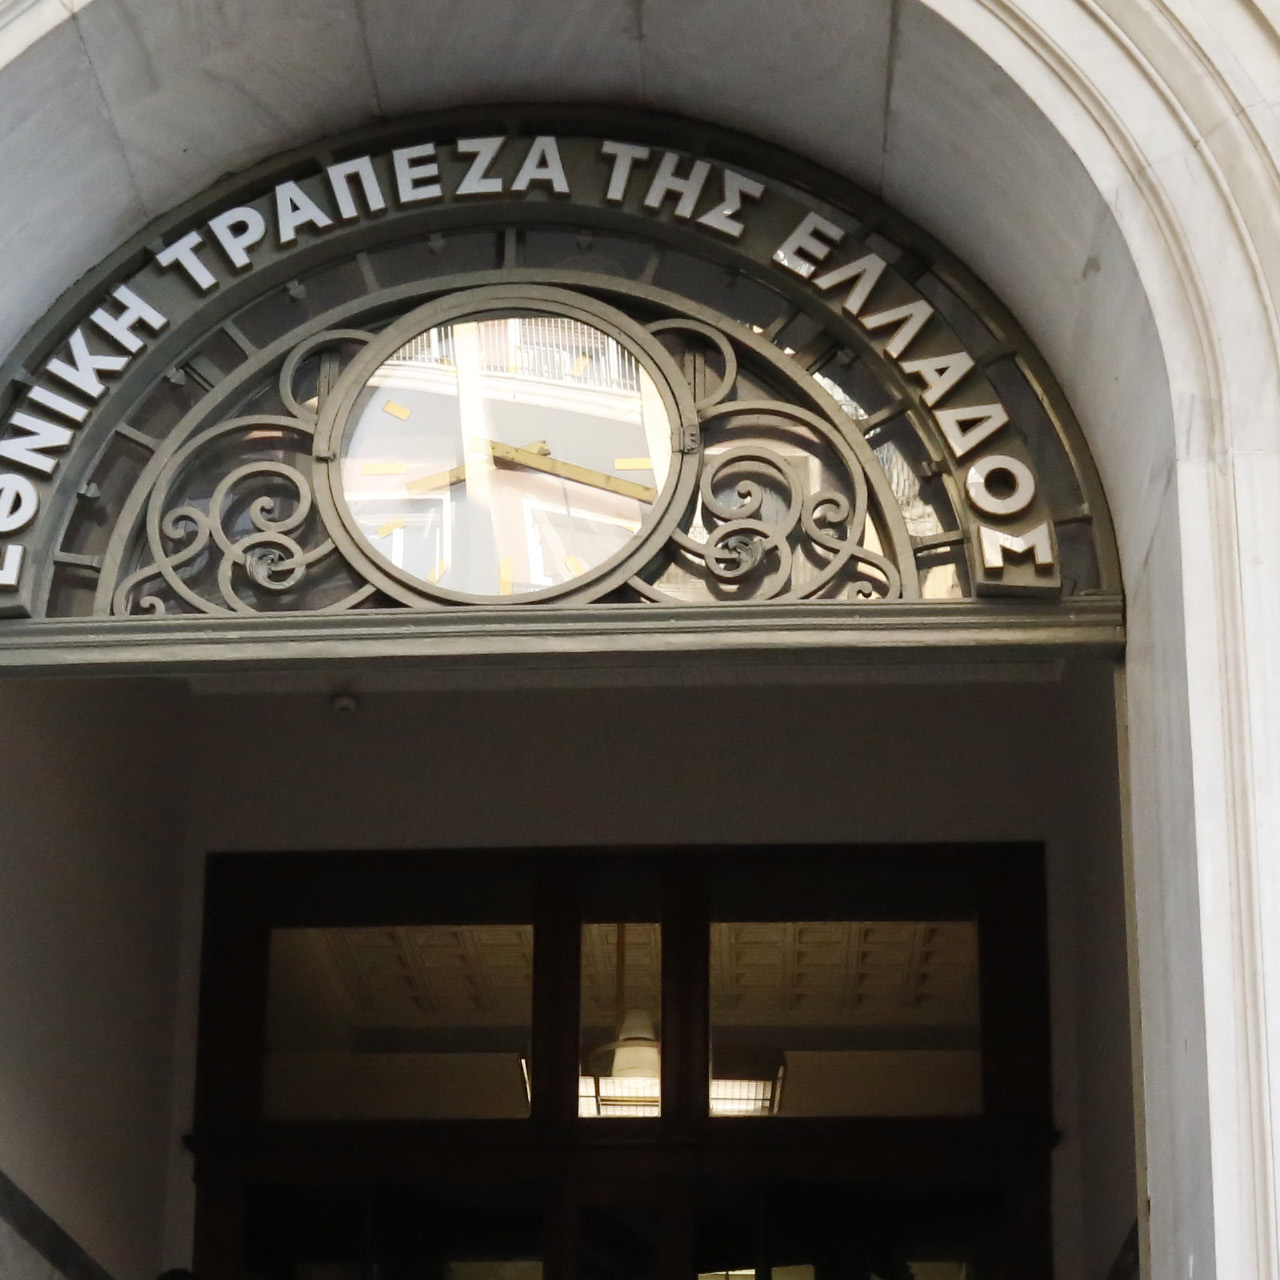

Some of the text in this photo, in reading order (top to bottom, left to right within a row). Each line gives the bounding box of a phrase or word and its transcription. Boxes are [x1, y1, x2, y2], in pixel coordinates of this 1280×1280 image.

[155, 136, 571, 292] ΤΡΑΠΕΖΑ
[601, 140, 765, 239] ΤΗΣ
[771, 211, 1054, 570] ΕΛΛΑΔΟΣ
